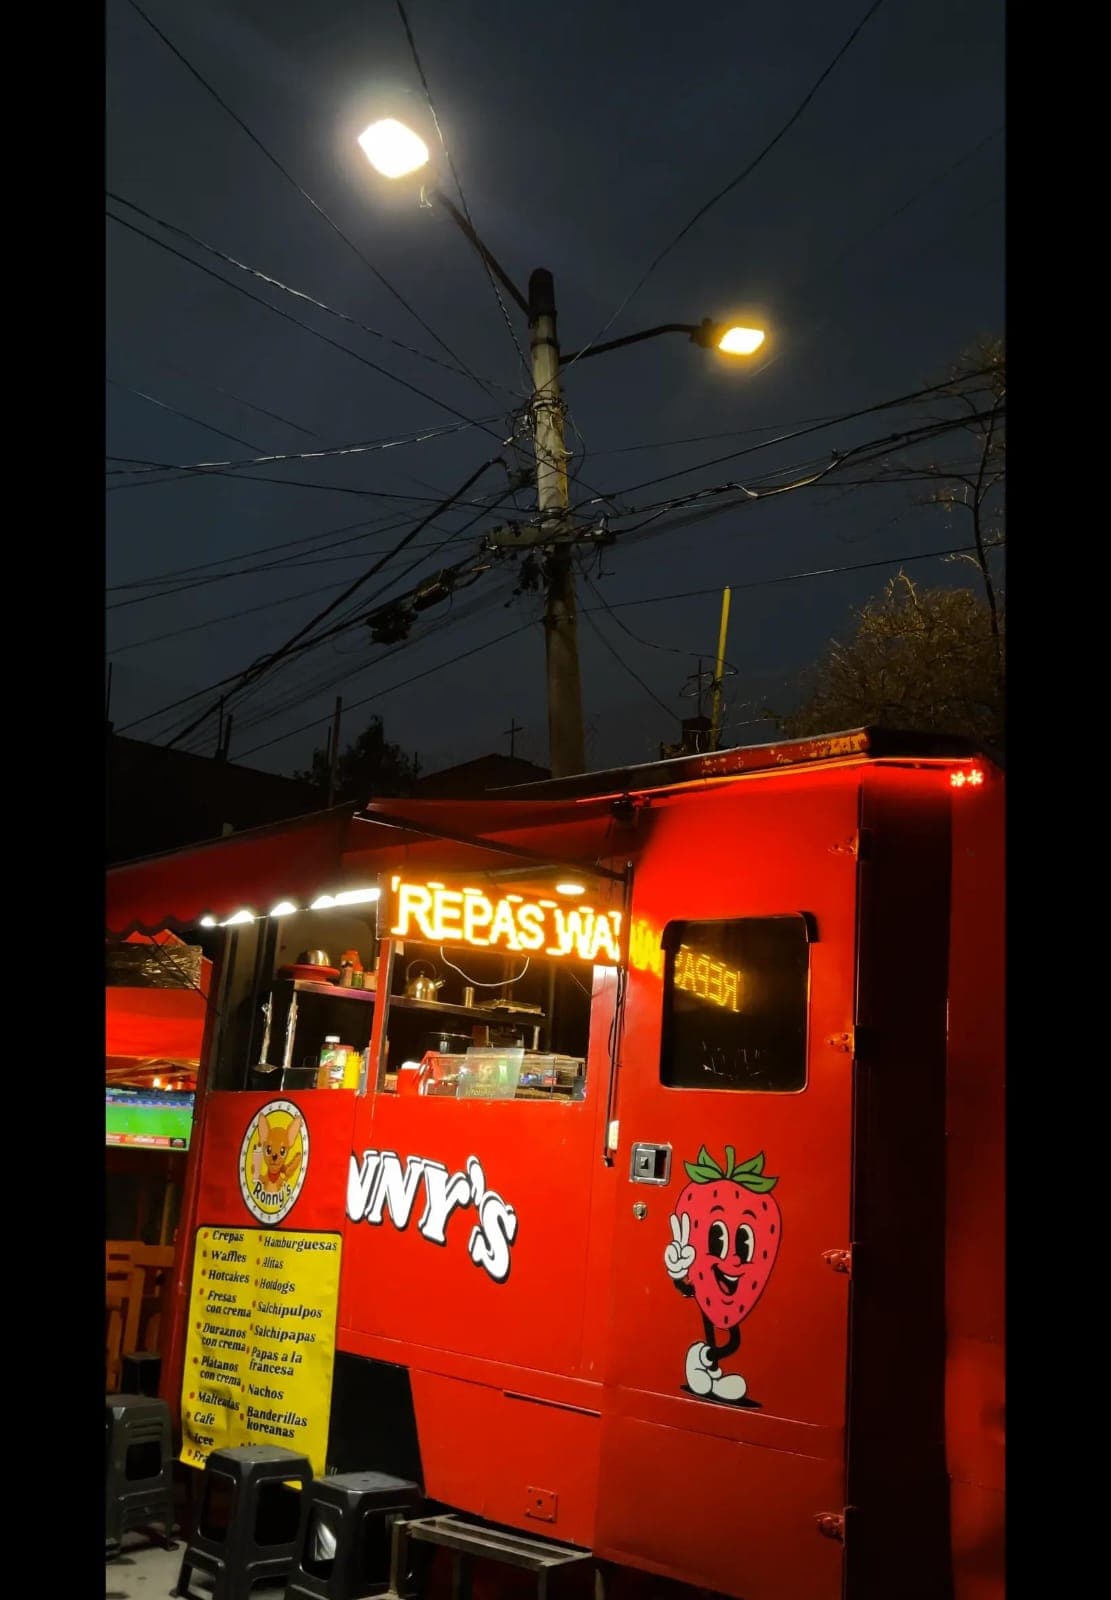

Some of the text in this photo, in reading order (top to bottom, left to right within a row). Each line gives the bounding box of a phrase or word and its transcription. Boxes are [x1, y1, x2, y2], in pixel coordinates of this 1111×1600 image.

[253, 1181, 292, 1208] Ronny's
[212, 1230, 244, 1244] Crepas
[263, 1236, 337, 1252] Hamburguesas
[211, 1250, 247, 1263] Waffles
[262, 1257, 284, 1269] Alitas
[208, 1269, 250, 1283] Hotcakes
[208, 1290, 237, 1303] Fresas
[206, 1304, 252, 1318] con crema
[257, 1301, 322, 1319] Salchipulpos
[203, 1322, 247, 1339] Duraznos
[254, 1325, 316, 1343] Salchipapas
[201, 1337, 246, 1352] con crema
[251, 1346, 303, 1364] Papas a la
[249, 1359, 294, 1376] francesa
[200, 1370, 241, 1387] con crema
[248, 1384, 284, 1400] Nachos
[194, 1411, 215, 1425] Café
[247, 1406, 307, 1427] Banderillas
[246, 1418, 294, 1439] koreanas
